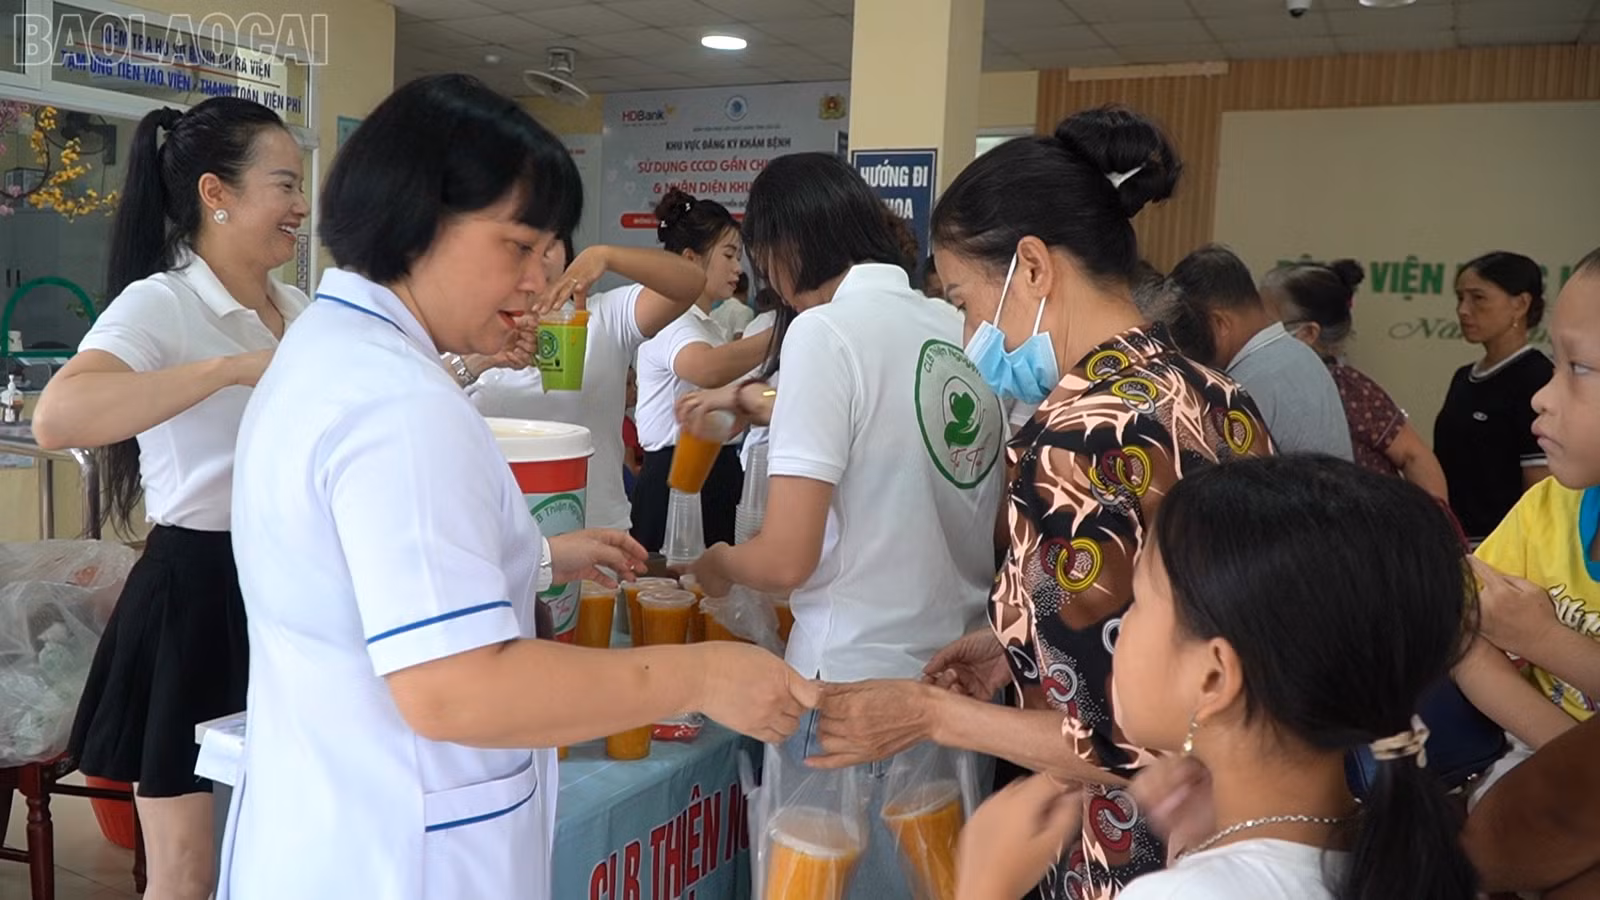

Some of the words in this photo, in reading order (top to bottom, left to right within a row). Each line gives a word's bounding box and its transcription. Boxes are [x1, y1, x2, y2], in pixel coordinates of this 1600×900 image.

[622, 109, 665, 122] HDBank
[666, 141, 682, 151] KHU
[690, 160, 718, 172] CCCD
[861, 159, 909, 187] HƯỚNG
[912, 166, 928, 187] ĐI
[1370, 254, 1444, 301] VIỆN
